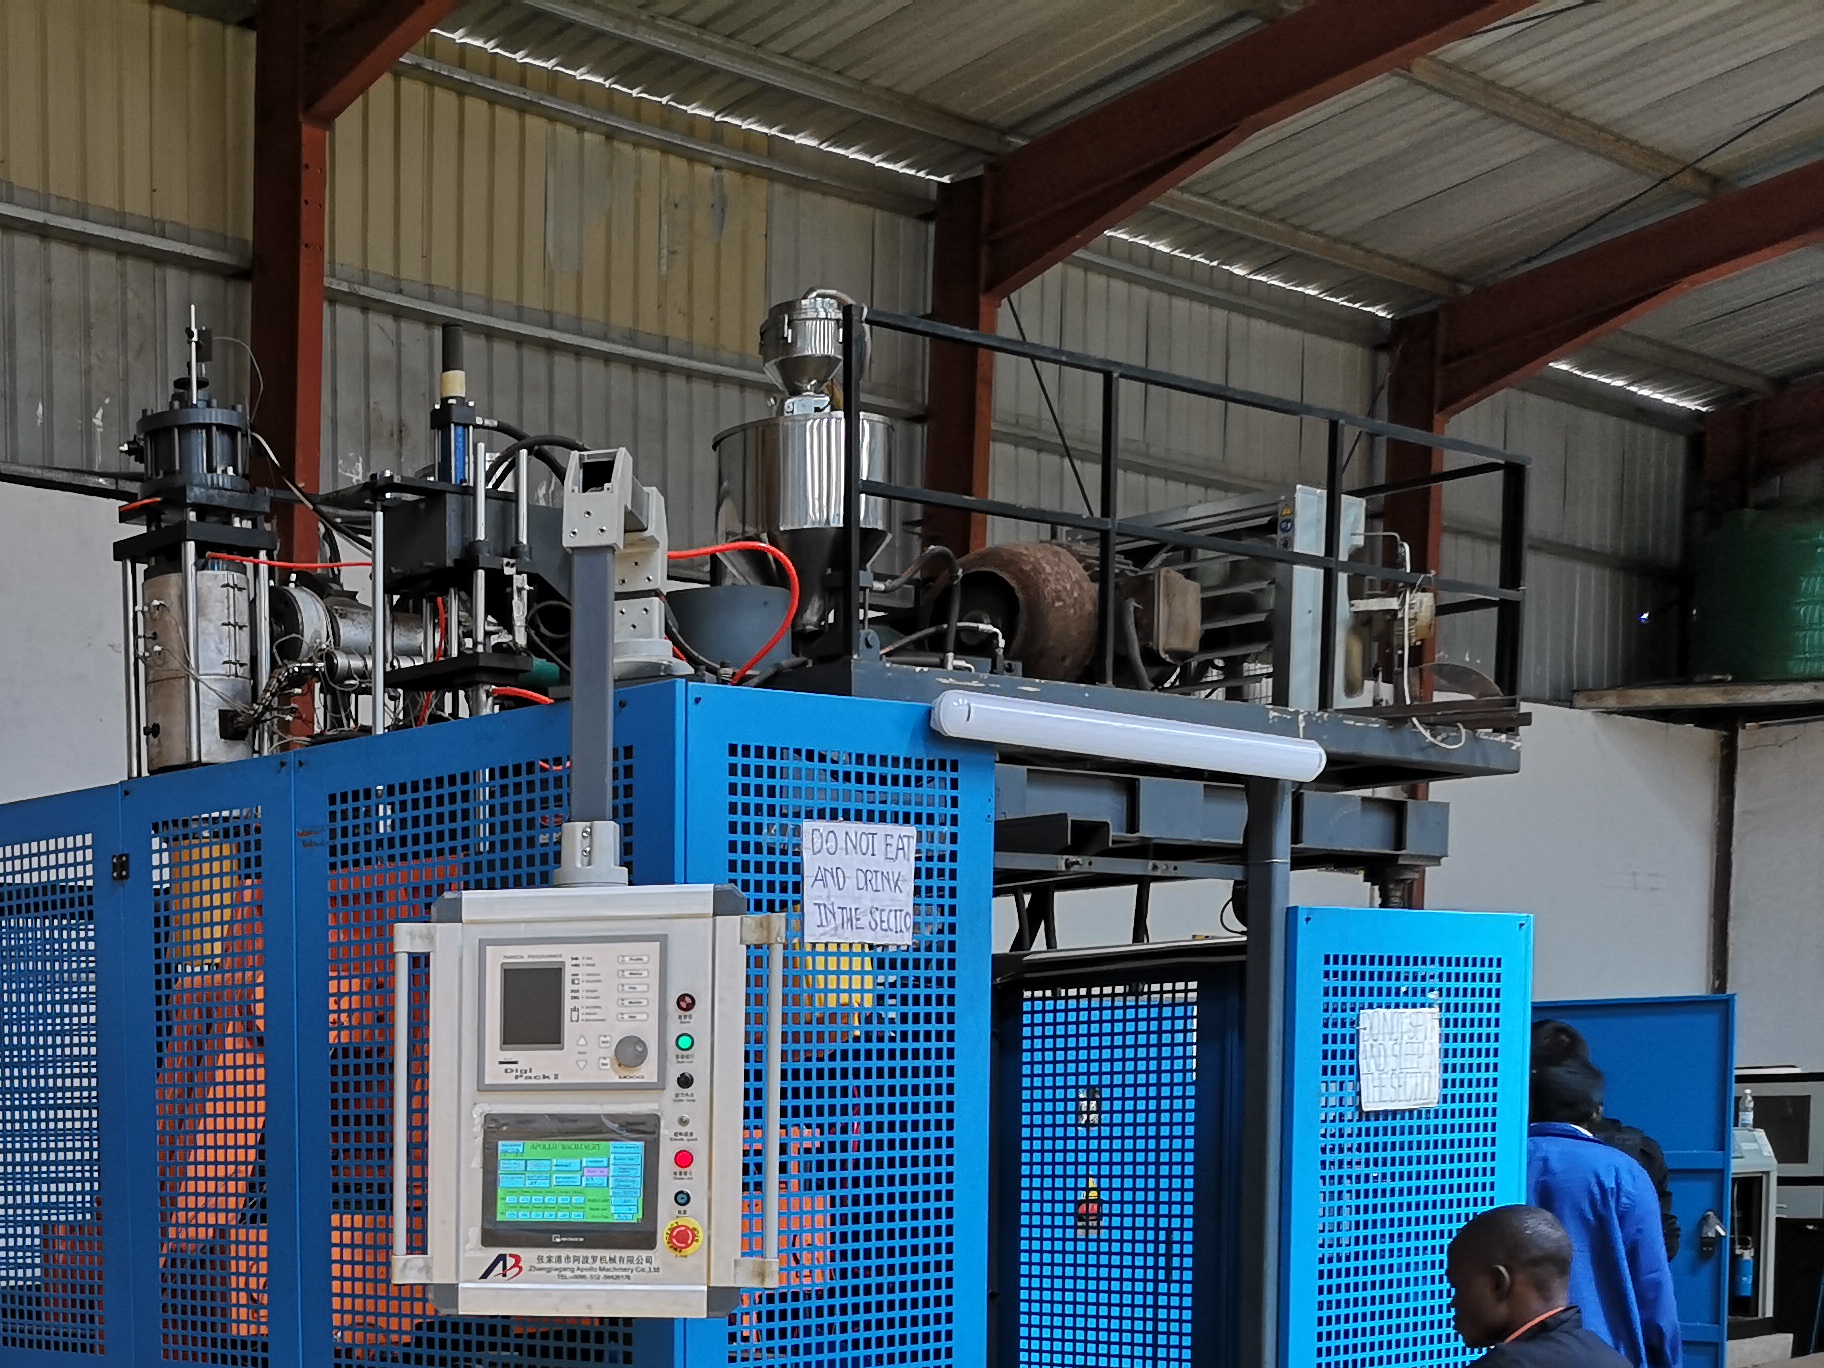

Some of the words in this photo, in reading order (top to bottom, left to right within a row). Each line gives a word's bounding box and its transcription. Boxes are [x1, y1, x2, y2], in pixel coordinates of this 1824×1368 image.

[811, 828, 838, 855] DO
[844, 831, 878, 856] NOT
[883, 833, 915, 862] EAT
[811, 865, 846, 891] AND
[856, 868, 903, 893] DRINK
[813, 901, 837, 928] IN
[837, 906, 865, 931] THE
